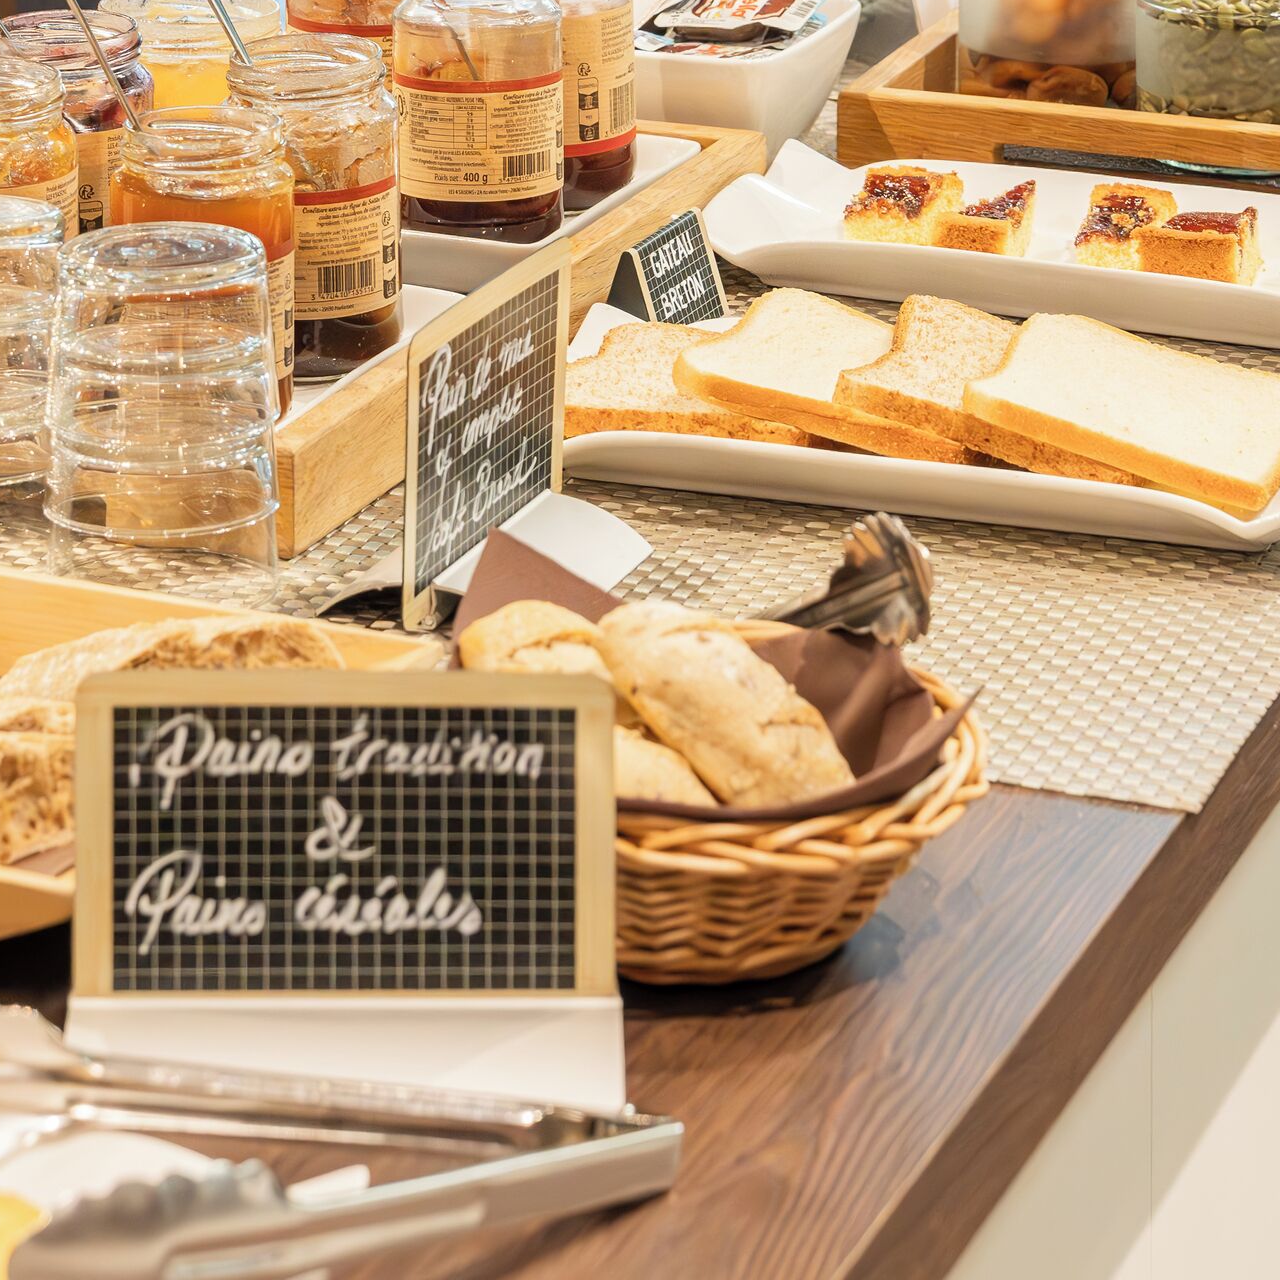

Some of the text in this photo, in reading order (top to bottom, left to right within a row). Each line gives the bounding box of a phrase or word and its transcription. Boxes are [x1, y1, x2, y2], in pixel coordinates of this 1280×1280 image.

[463, 172, 480, 182] 400
[482, 174, 488, 185] g
[649, 230, 694, 279] GATEAU
[660, 269, 705, 320] BRETON
[421, 341, 467, 457] Pain
[471, 333, 492, 401] de
[460, 381, 523, 455] complet
[472, 436, 537, 522] Bread
[329, 712, 545, 782] tradition
[305, 795, 376, 862] &
